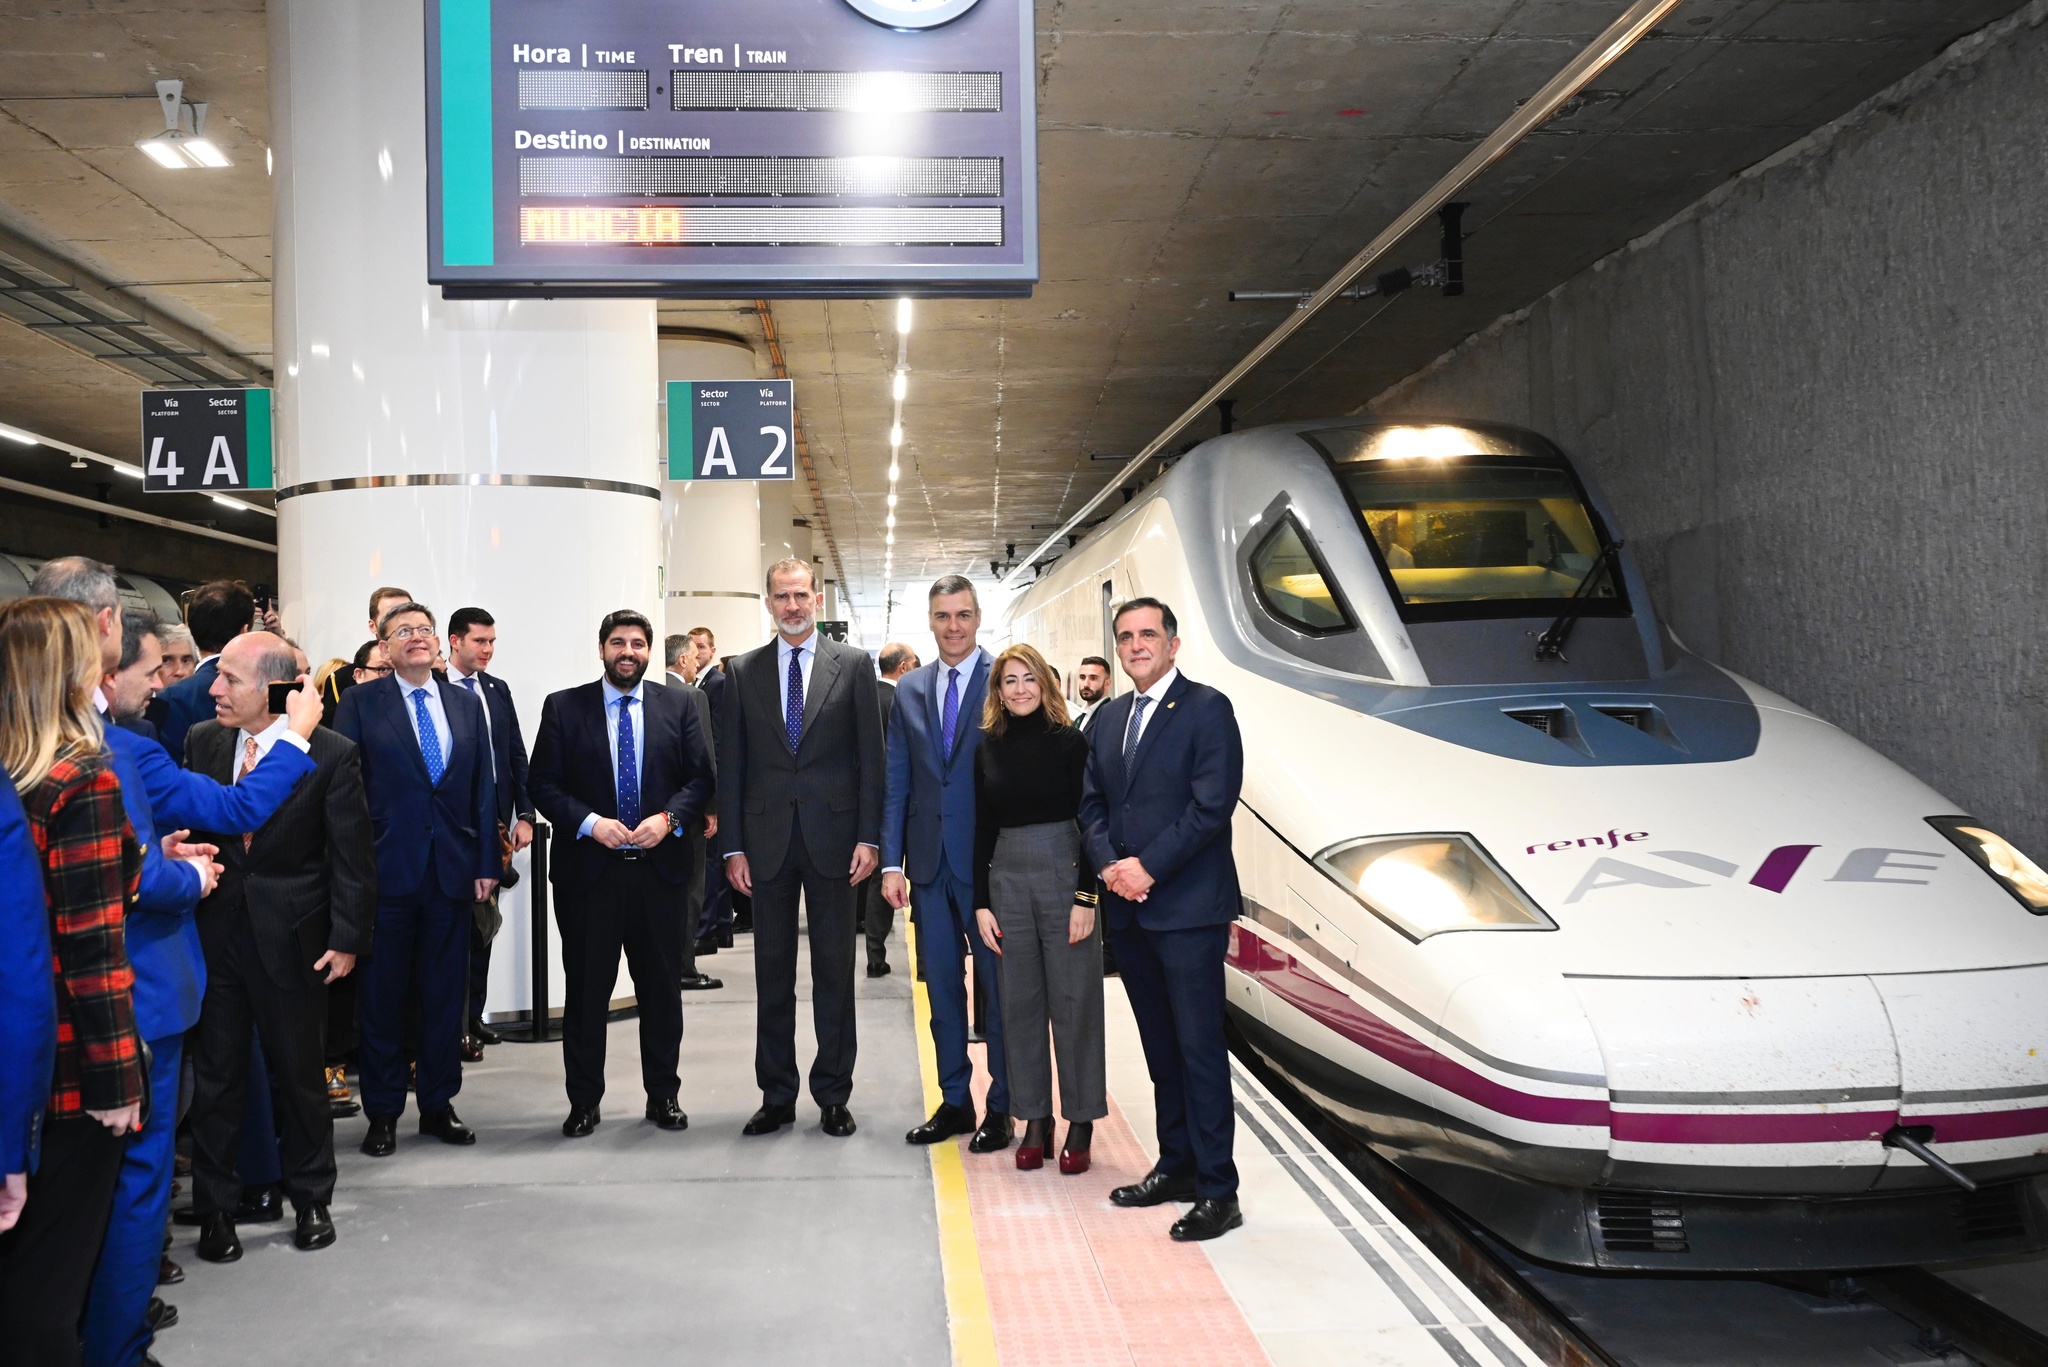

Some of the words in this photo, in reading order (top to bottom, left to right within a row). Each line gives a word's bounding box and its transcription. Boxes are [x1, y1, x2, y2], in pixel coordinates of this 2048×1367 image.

[513, 44, 571, 63] Hora
[595, 51, 636, 64] TIME
[668, 44, 723, 63] Tren
[746, 51, 787, 64] TRAIN
[515, 130, 608, 150] Destino
[630, 138, 711, 150] DESTINATION
[164, 398, 178, 408] Vía
[209, 398, 238, 406] Sector
[700, 389, 729, 398] Sector
[760, 388, 774, 398] Vía
[147, 437, 185, 486] 4
[202, 435, 240, 485] A
[701, 426, 737, 476] A
[760, 425, 788, 475] 2
[1526, 828, 1650, 855] renfe
[1562, 843, 1946, 905] AVE
